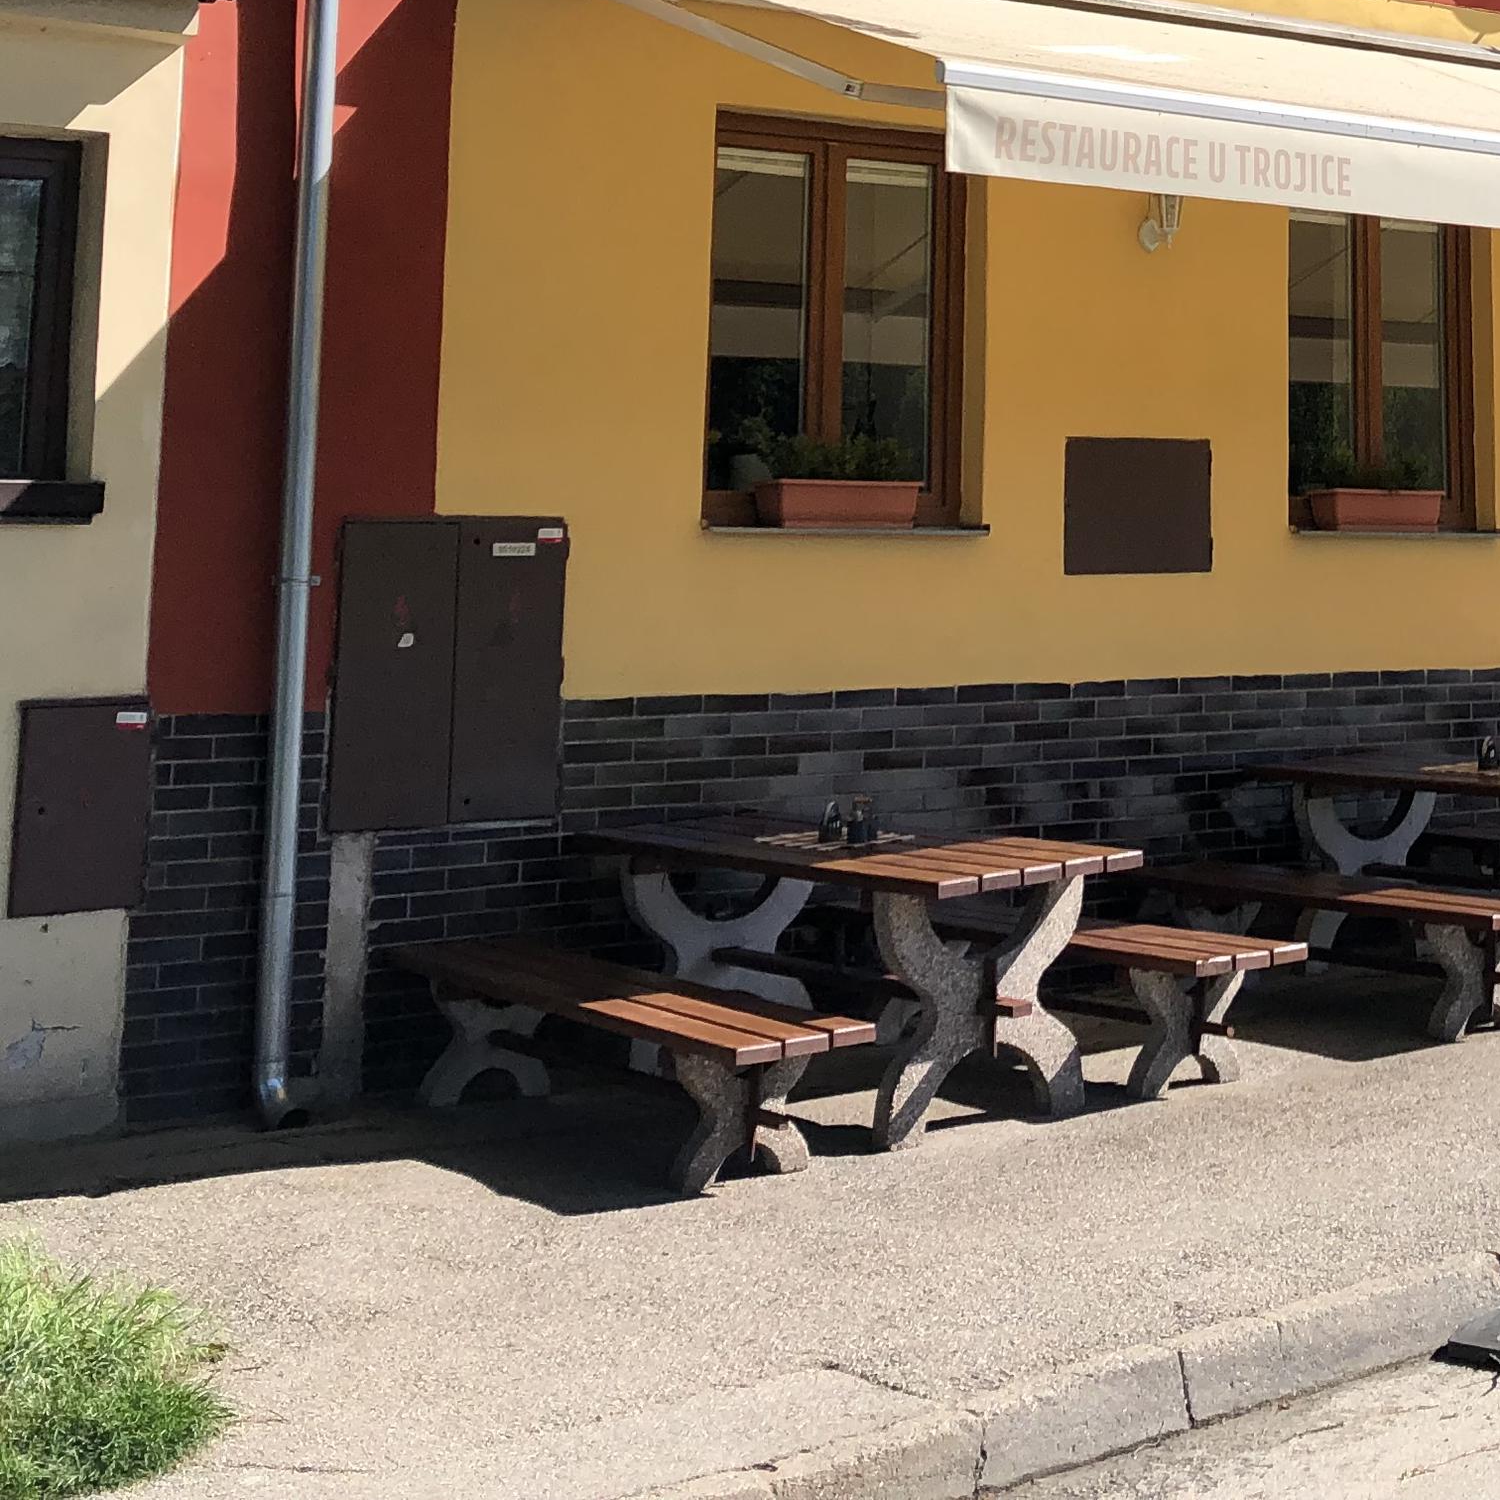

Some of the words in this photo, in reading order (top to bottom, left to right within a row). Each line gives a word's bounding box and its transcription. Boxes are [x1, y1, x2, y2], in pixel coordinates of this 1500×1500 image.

[994, 116, 1199, 181] RESTAURACE
[1208, 141, 1226, 184] U
[1234, 144, 1353, 197] TROJICE
